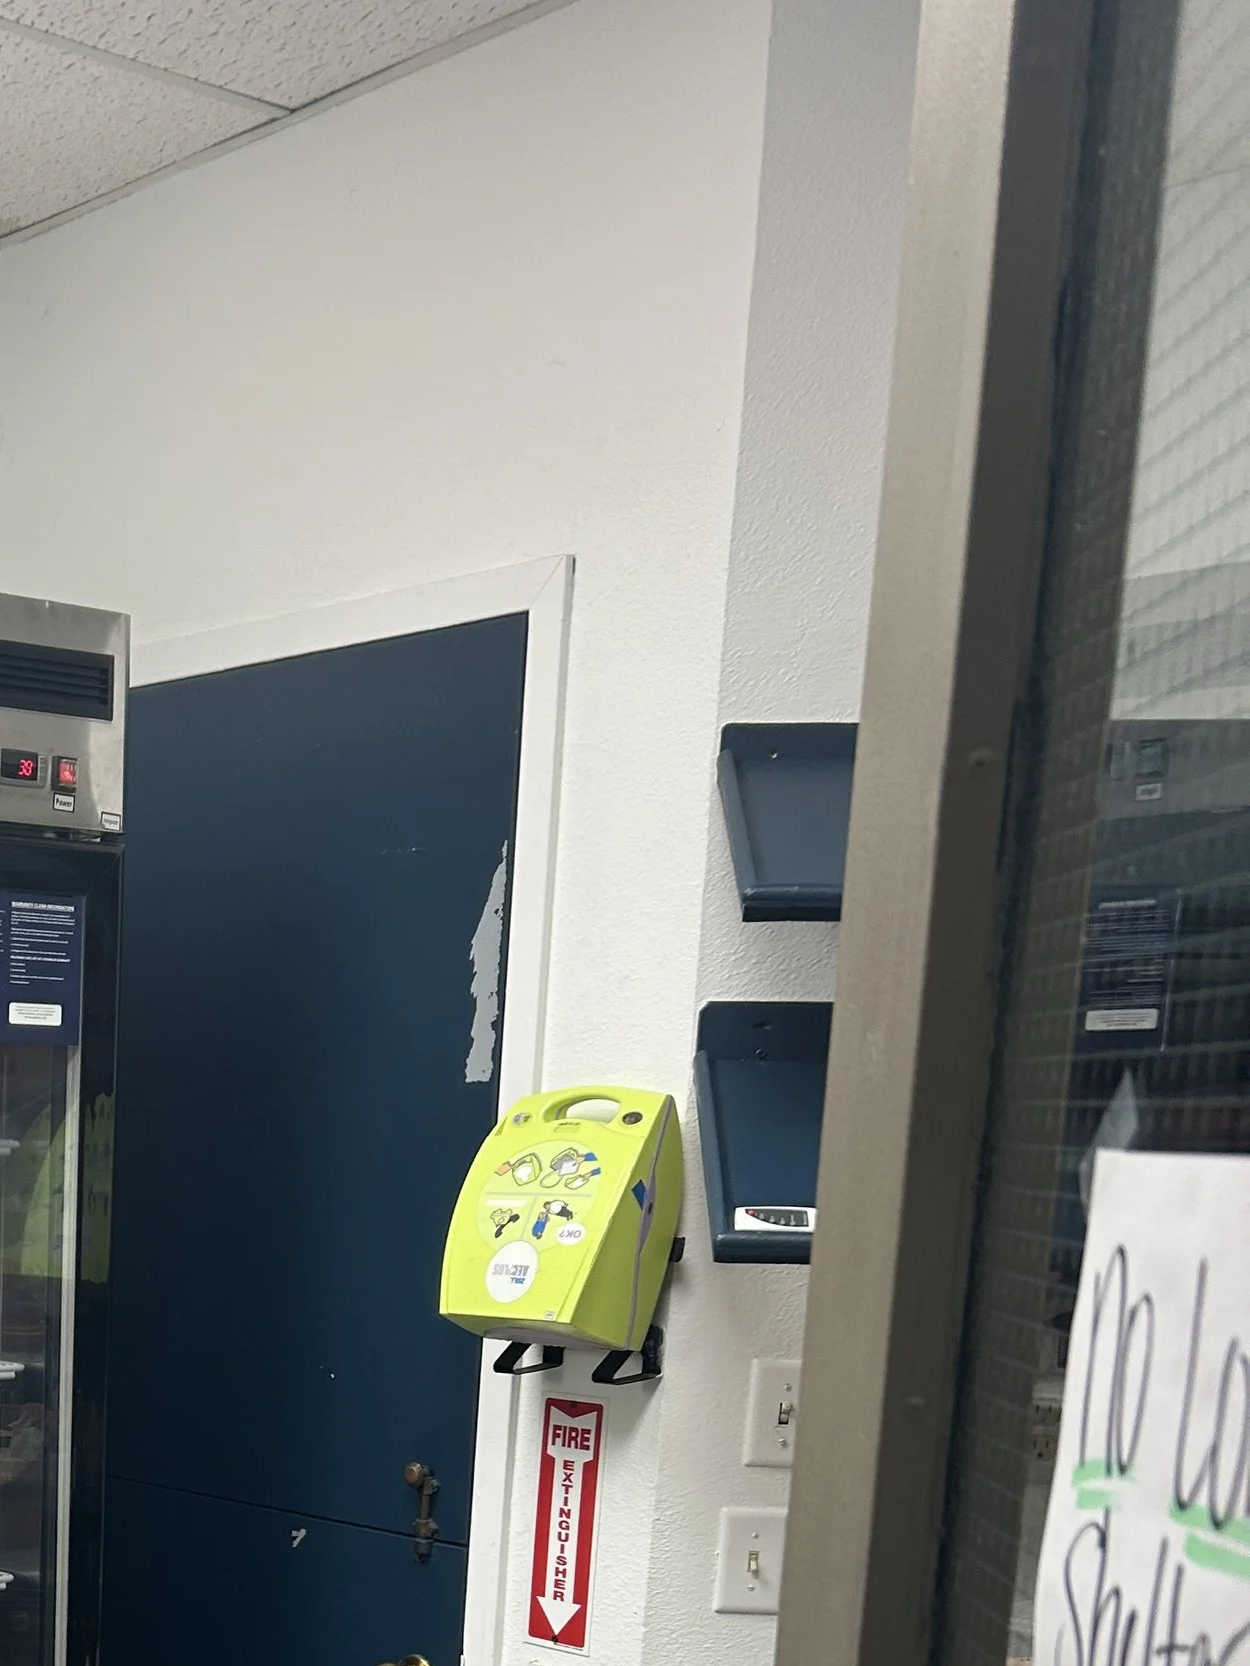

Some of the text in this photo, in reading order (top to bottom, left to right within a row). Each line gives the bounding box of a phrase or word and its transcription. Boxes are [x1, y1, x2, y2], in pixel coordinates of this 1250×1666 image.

[18, 759, 35, 776] 39
[55, 797, 72, 808] Power
[558, 1229, 582, 1239] OK?
[551, 1424, 591, 1450] FIRE
[552, 1459, 575, 1602] EXTINGUISHER
